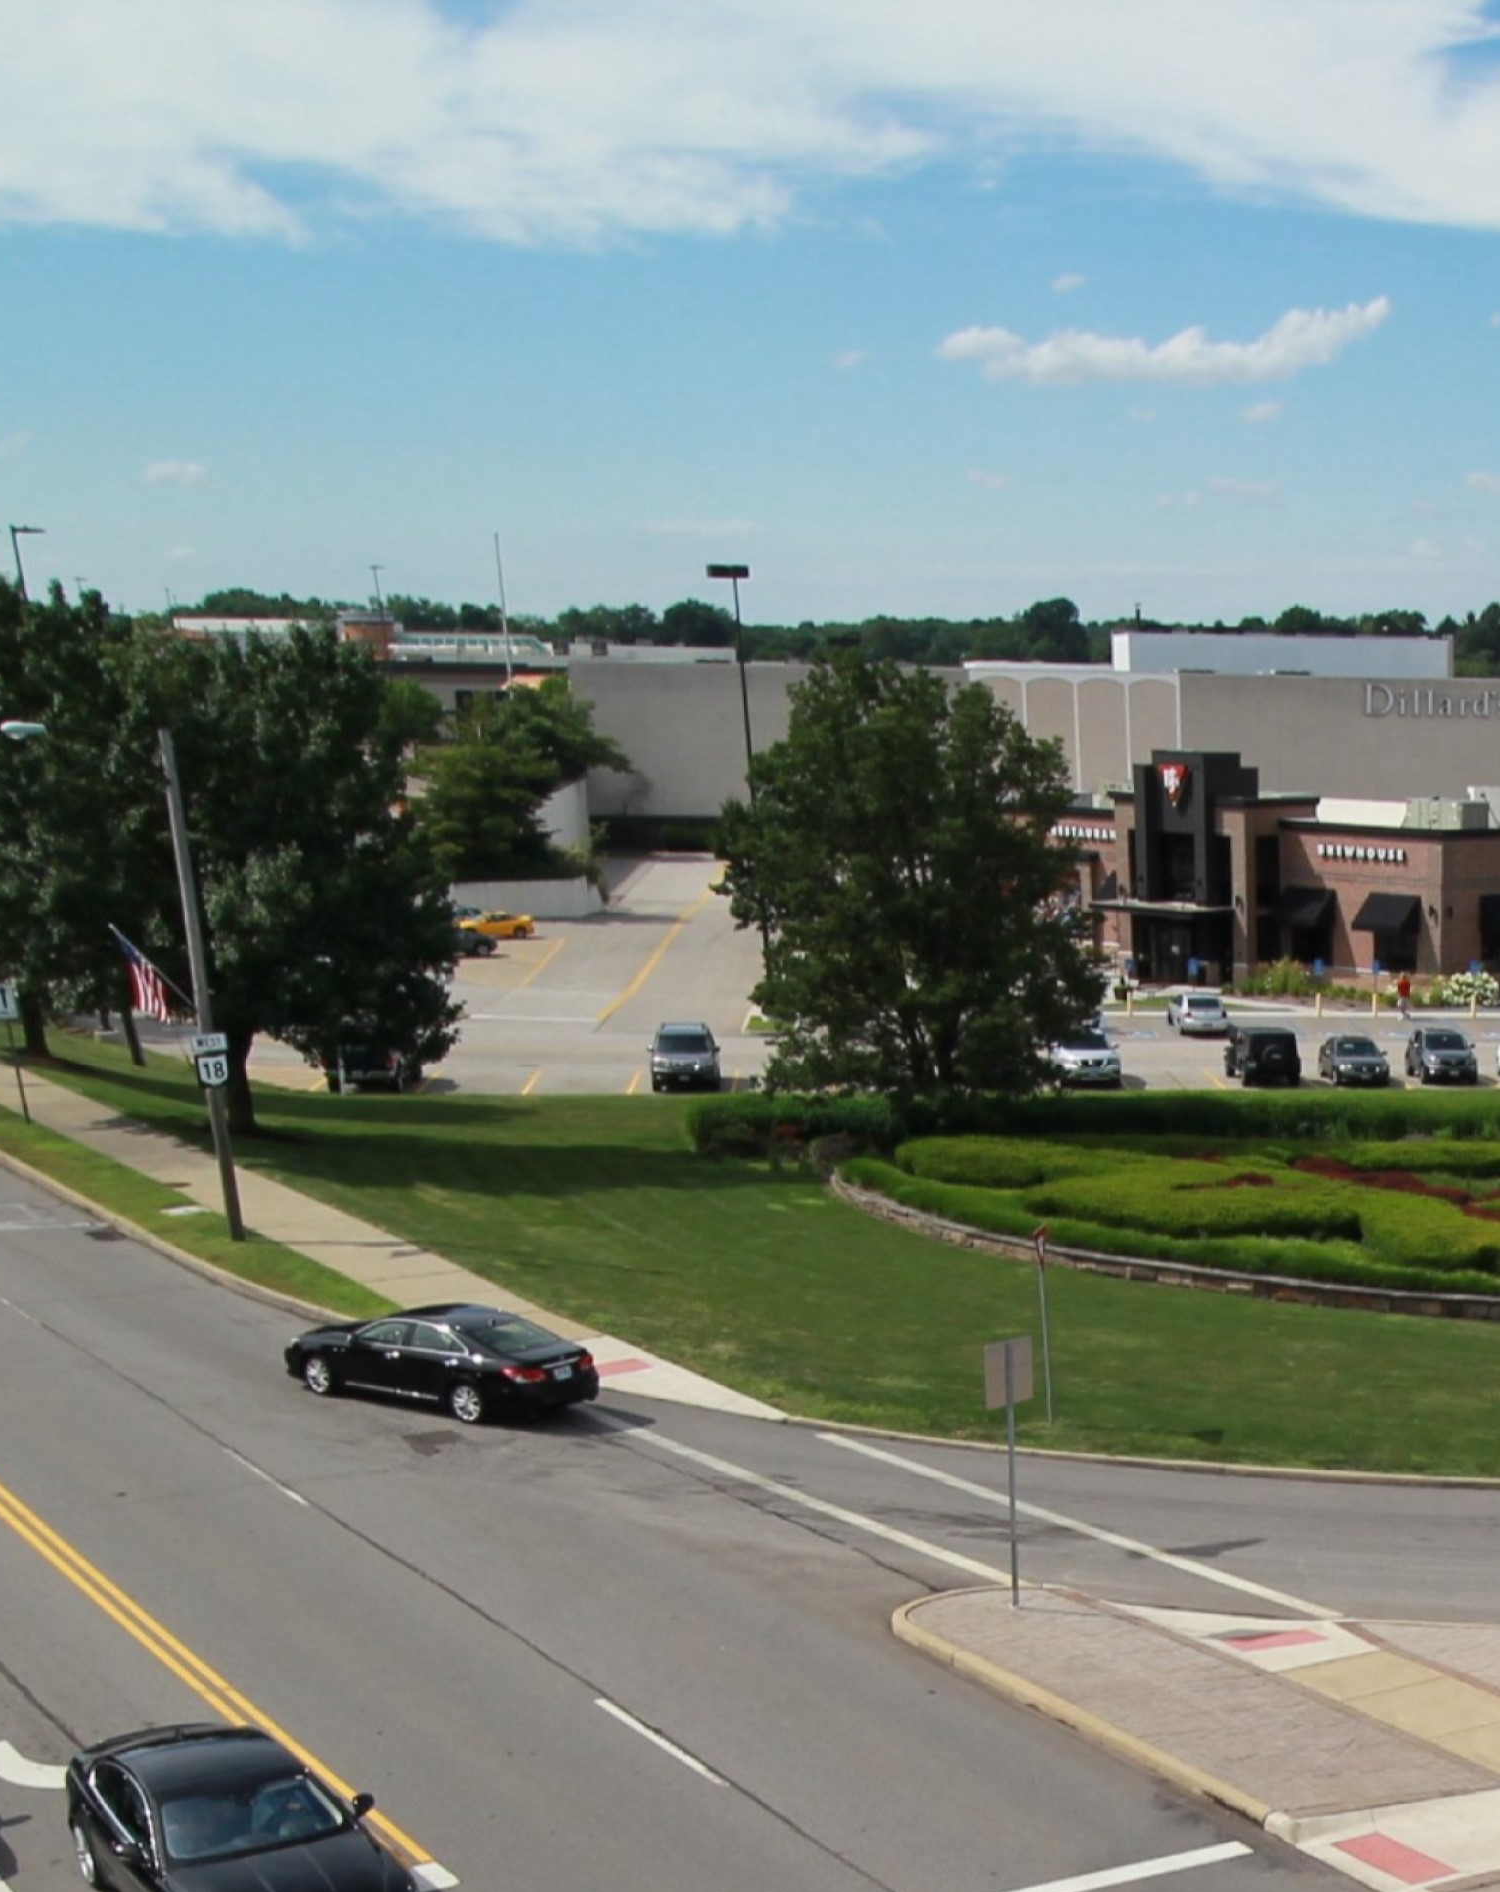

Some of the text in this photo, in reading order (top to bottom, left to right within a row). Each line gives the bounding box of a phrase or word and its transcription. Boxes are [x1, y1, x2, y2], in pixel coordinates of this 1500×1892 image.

[1049, 825, 1117, 841] RESTAURAN
[1317, 844, 1404, 861] BREWHOUSE
[203, 1061, 224, 1081] 18
